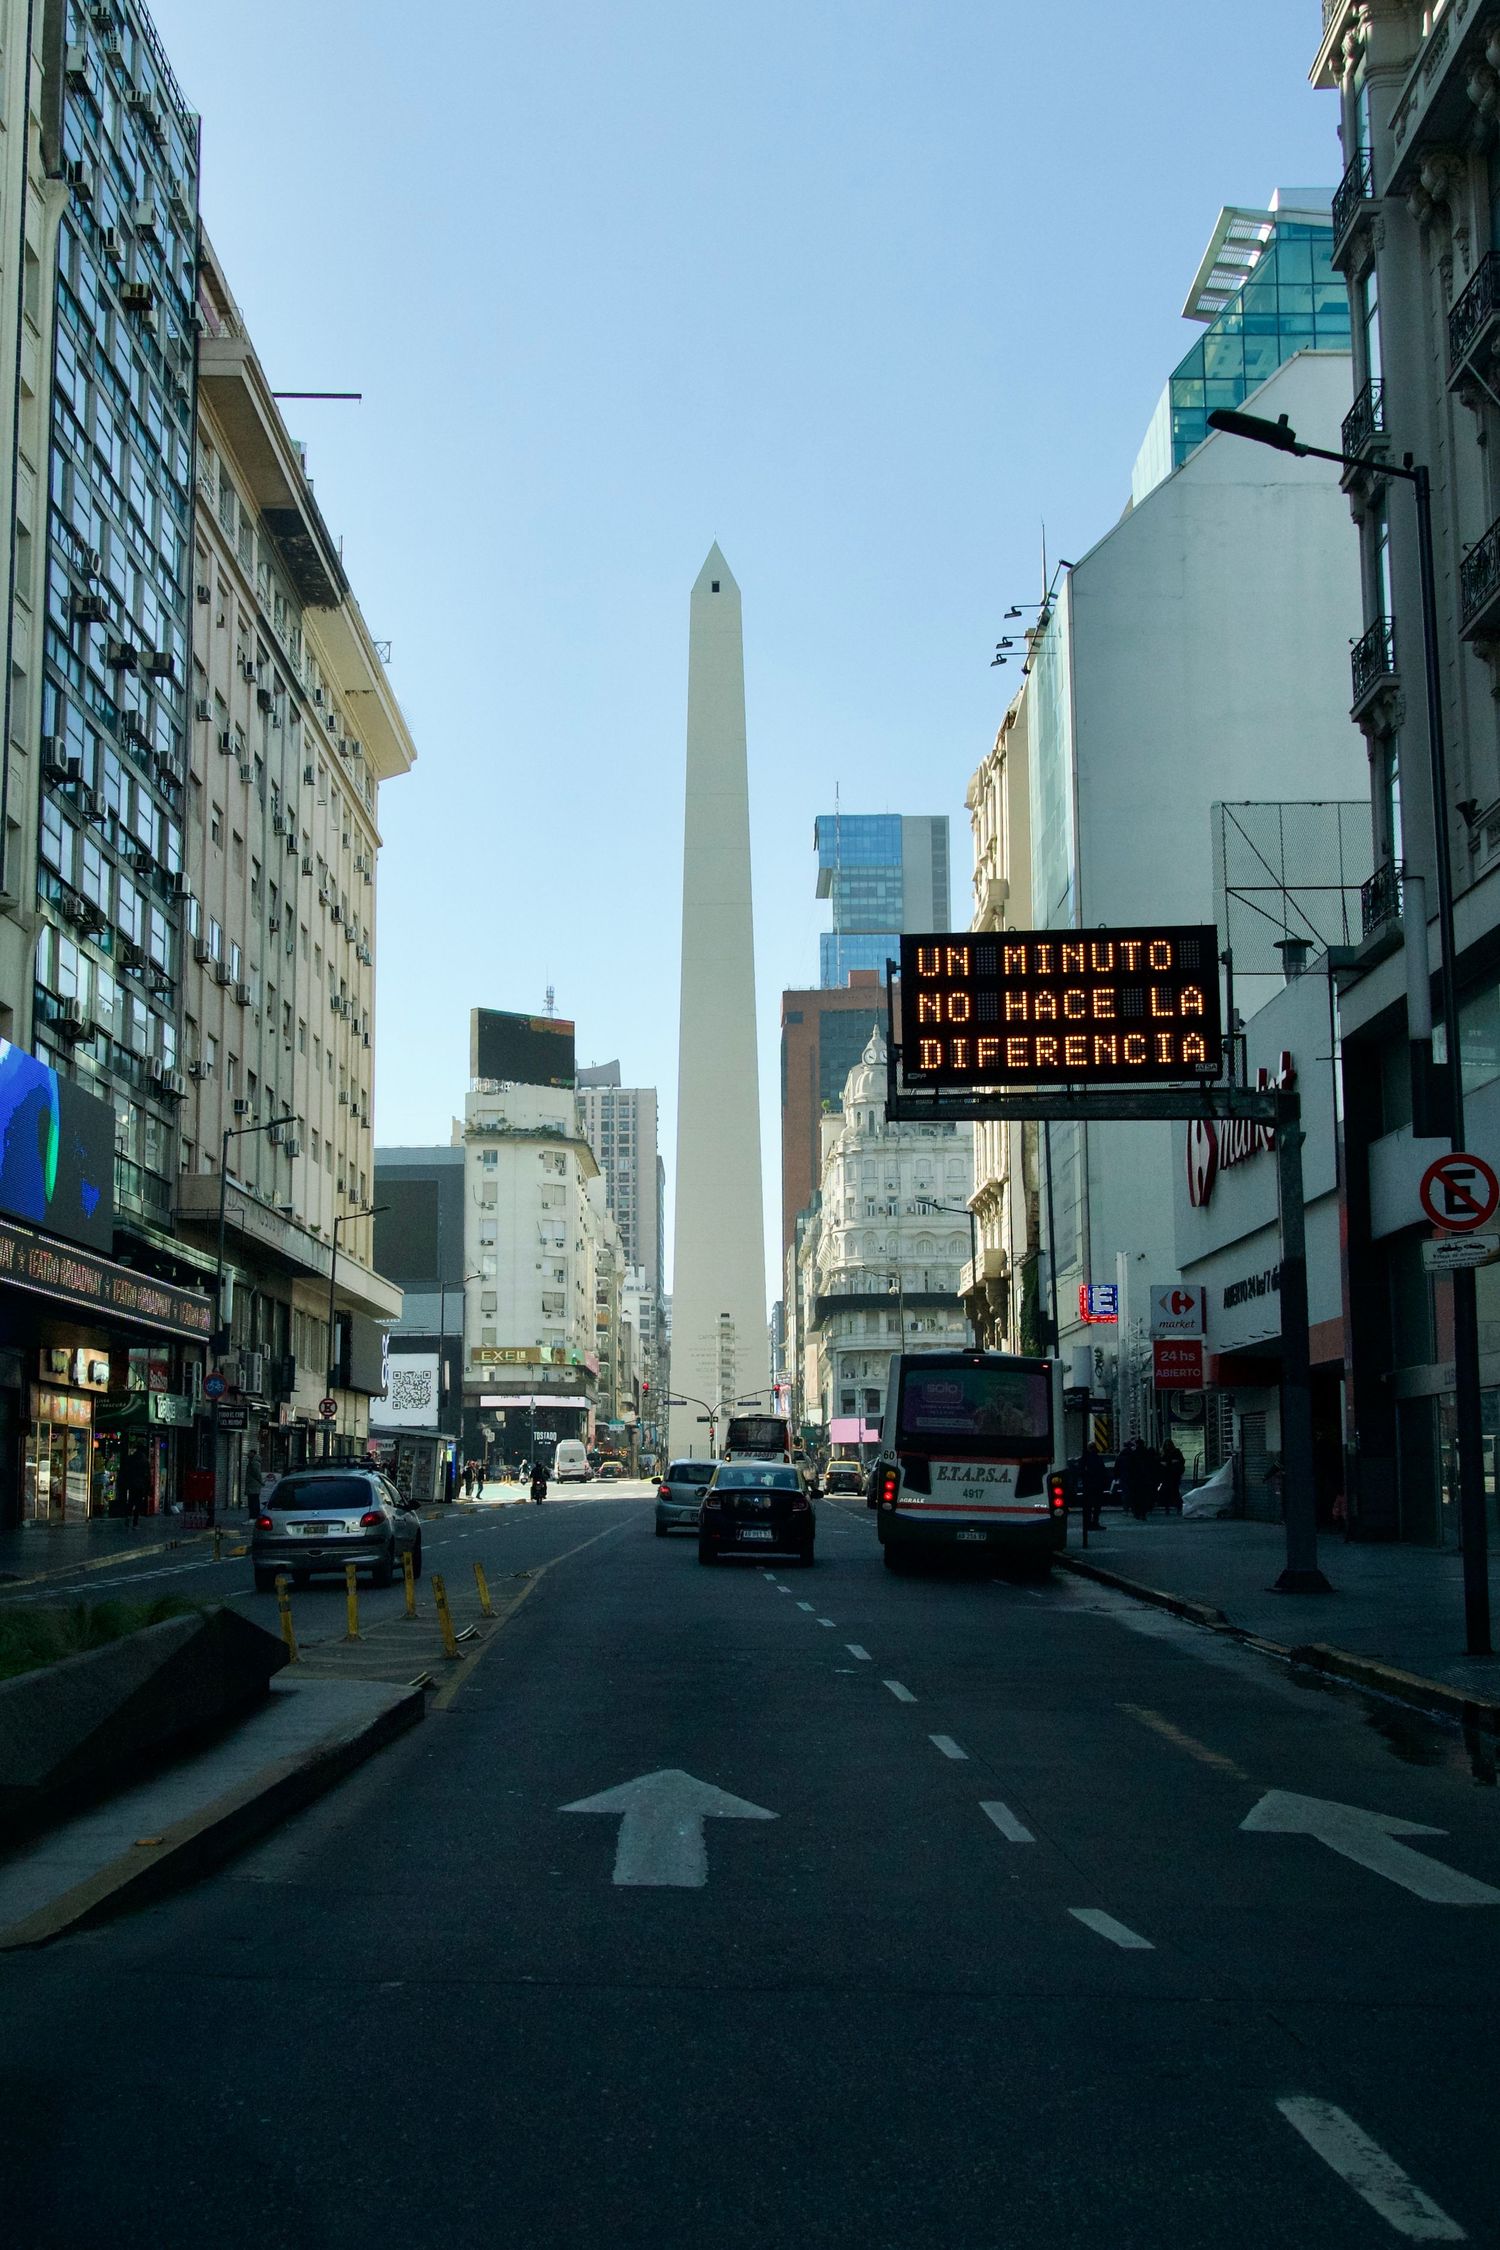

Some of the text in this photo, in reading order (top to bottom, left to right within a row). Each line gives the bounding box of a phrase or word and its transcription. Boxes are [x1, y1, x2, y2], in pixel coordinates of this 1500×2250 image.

[917, 940, 1172, 977] UN MINUTO
[918, 985, 1204, 1023] NO HACE LA
[919, 1032, 1206, 1070] DIFERENCIA
[60, 1257, 103, 1297] BROADWAY
[1223, 1280, 1248, 1309] ABIERTO
[1248, 1275, 1256, 1299] 24
[1159, 1320, 1195, 1328] market
[1160, 1350, 1196, 1361] 24 hs
[1155, 1368, 1201, 1377] ABIERTO
[533, 1431, 557, 1442] TOSTADO
[883, 1450, 895, 1460] 60
[936, 1466, 1012, 1483] E.T.A.P.S.A.
[962, 1488, 984, 1499] 4917
